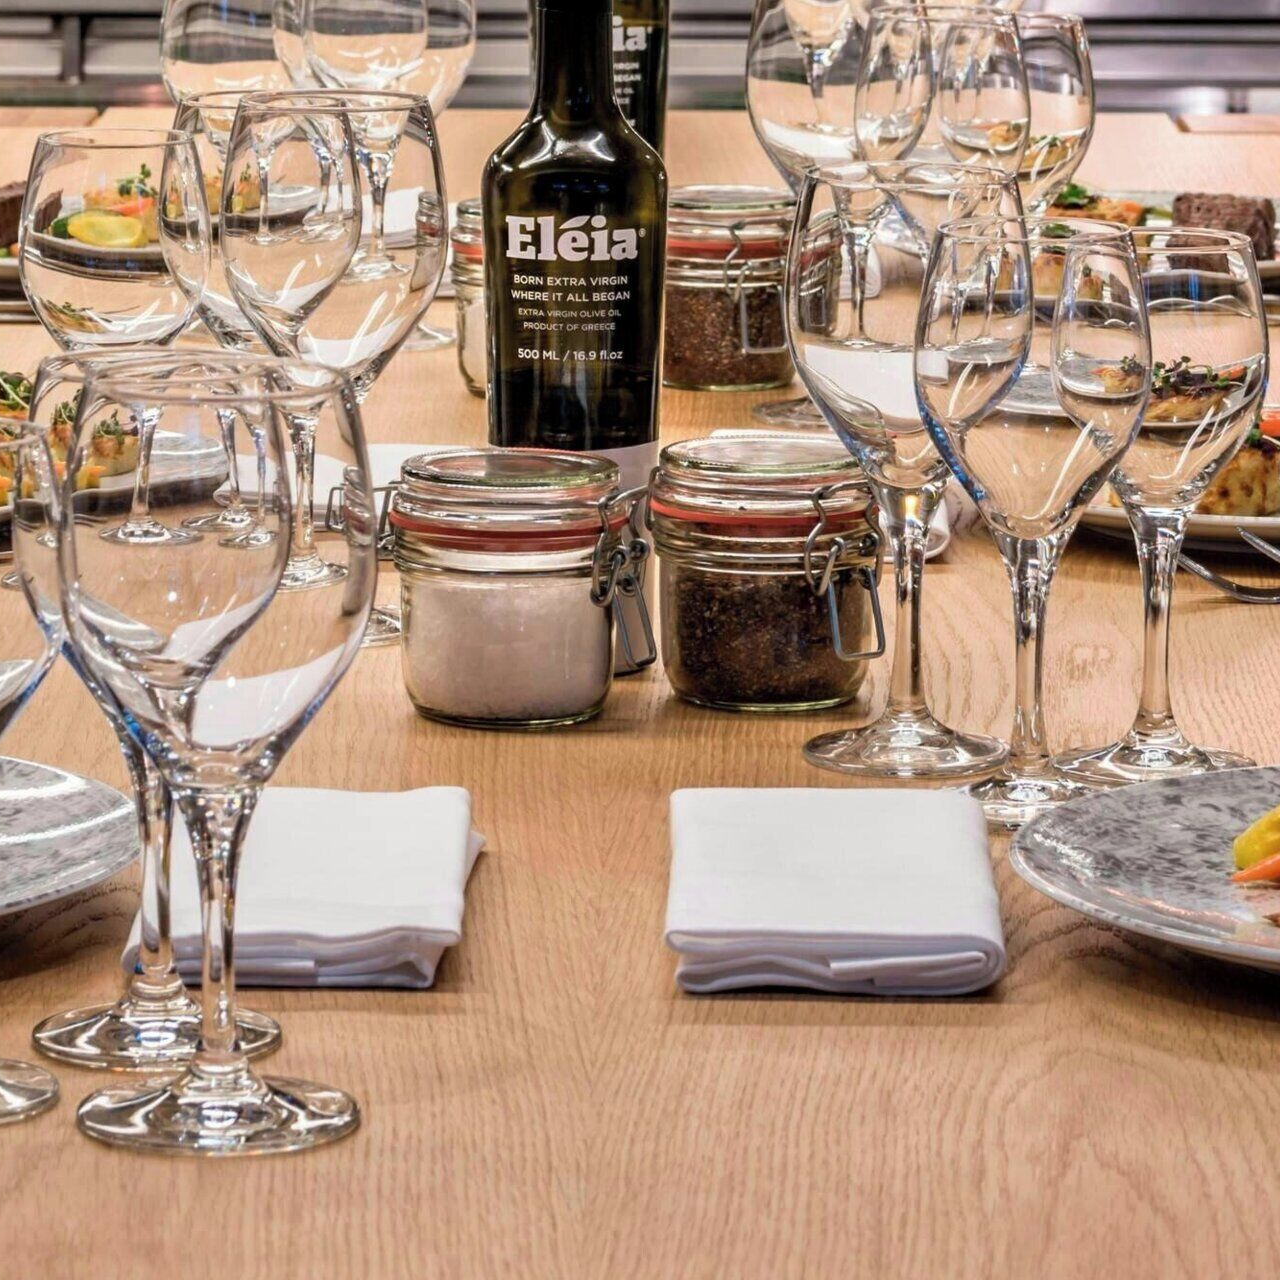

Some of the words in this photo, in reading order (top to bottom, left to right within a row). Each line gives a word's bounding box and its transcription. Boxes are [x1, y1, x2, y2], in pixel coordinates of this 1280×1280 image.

[505, 215, 639, 262] Eléia
[513, 274, 543, 286] BORN
[547, 276, 587, 286] EXTRA
[590, 275, 628, 286] VIRGIN
[511, 289, 549, 301] WHERE
[552, 292, 563, 301] IT
[566, 293, 589, 302] ALL
[592, 291, 631, 301] BEGAN
[518, 308, 545, 317] EXTRA
[608, 309, 622, 317] OIL
[523, 321, 563, 331] PRODUCT
[566, 323, 579, 331] OF
[581, 322, 616, 331] GREECE
[518, 348, 540, 359] 500
[542, 350, 560, 360] ML
[573, 351, 596, 360] 16.9
[600, 350, 623, 360] fl.oz
